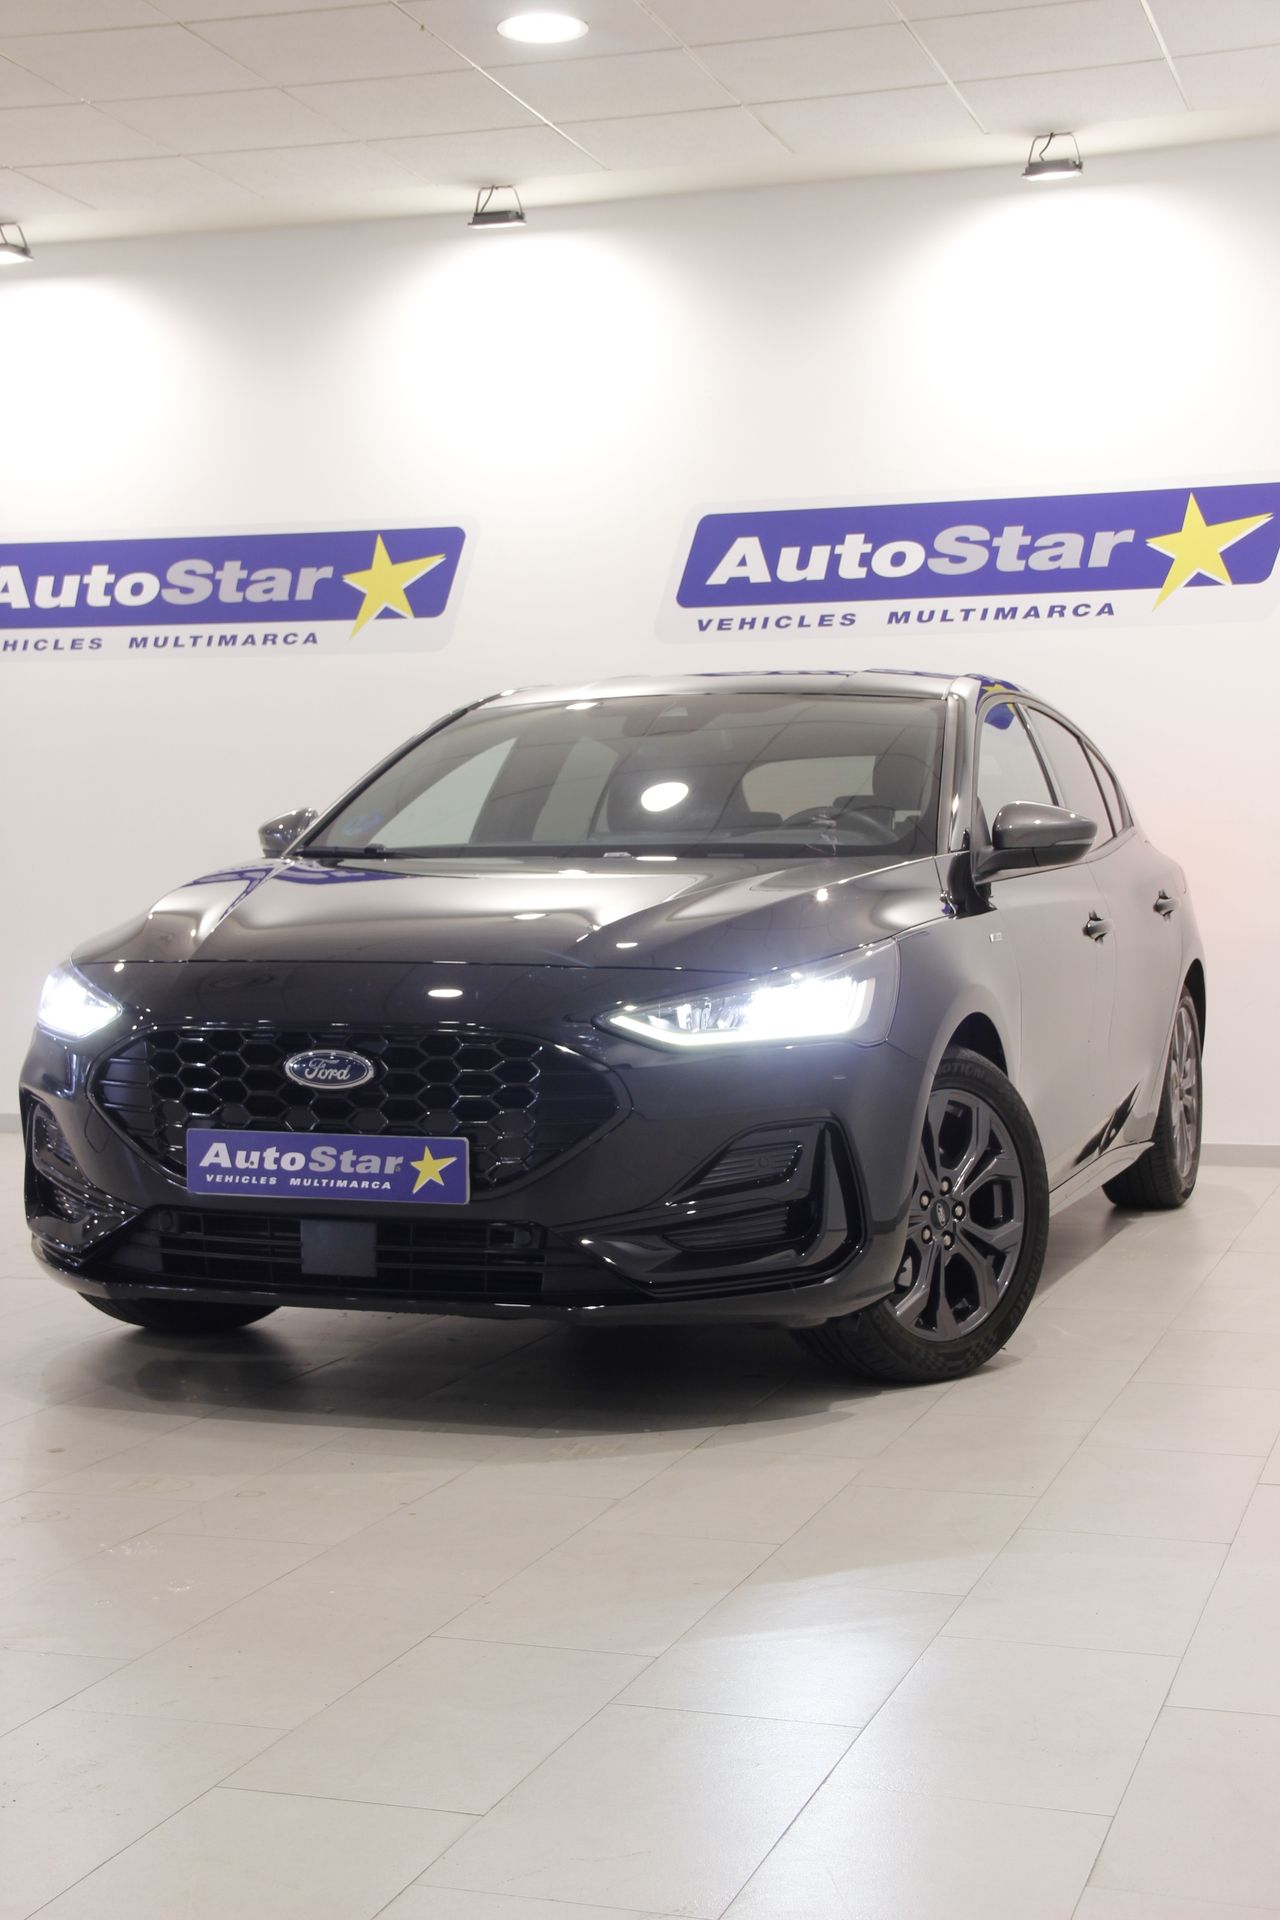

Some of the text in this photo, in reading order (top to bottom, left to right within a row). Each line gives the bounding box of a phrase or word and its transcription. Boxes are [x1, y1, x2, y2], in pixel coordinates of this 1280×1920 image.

[705, 524, 1135, 586] AutoStar
[0, 559, 334, 609] AutoStar
[697, 602, 1116, 632] VEHICLES MULTIMARCA
[2, 632, 320, 652] HICLES MULTIMARCA
[304, 1057, 351, 1081] Ford
[199, 1141, 404, 1175] AutoStar
[205, 1174, 392, 1190] VEHICLES MULTIMARCA
